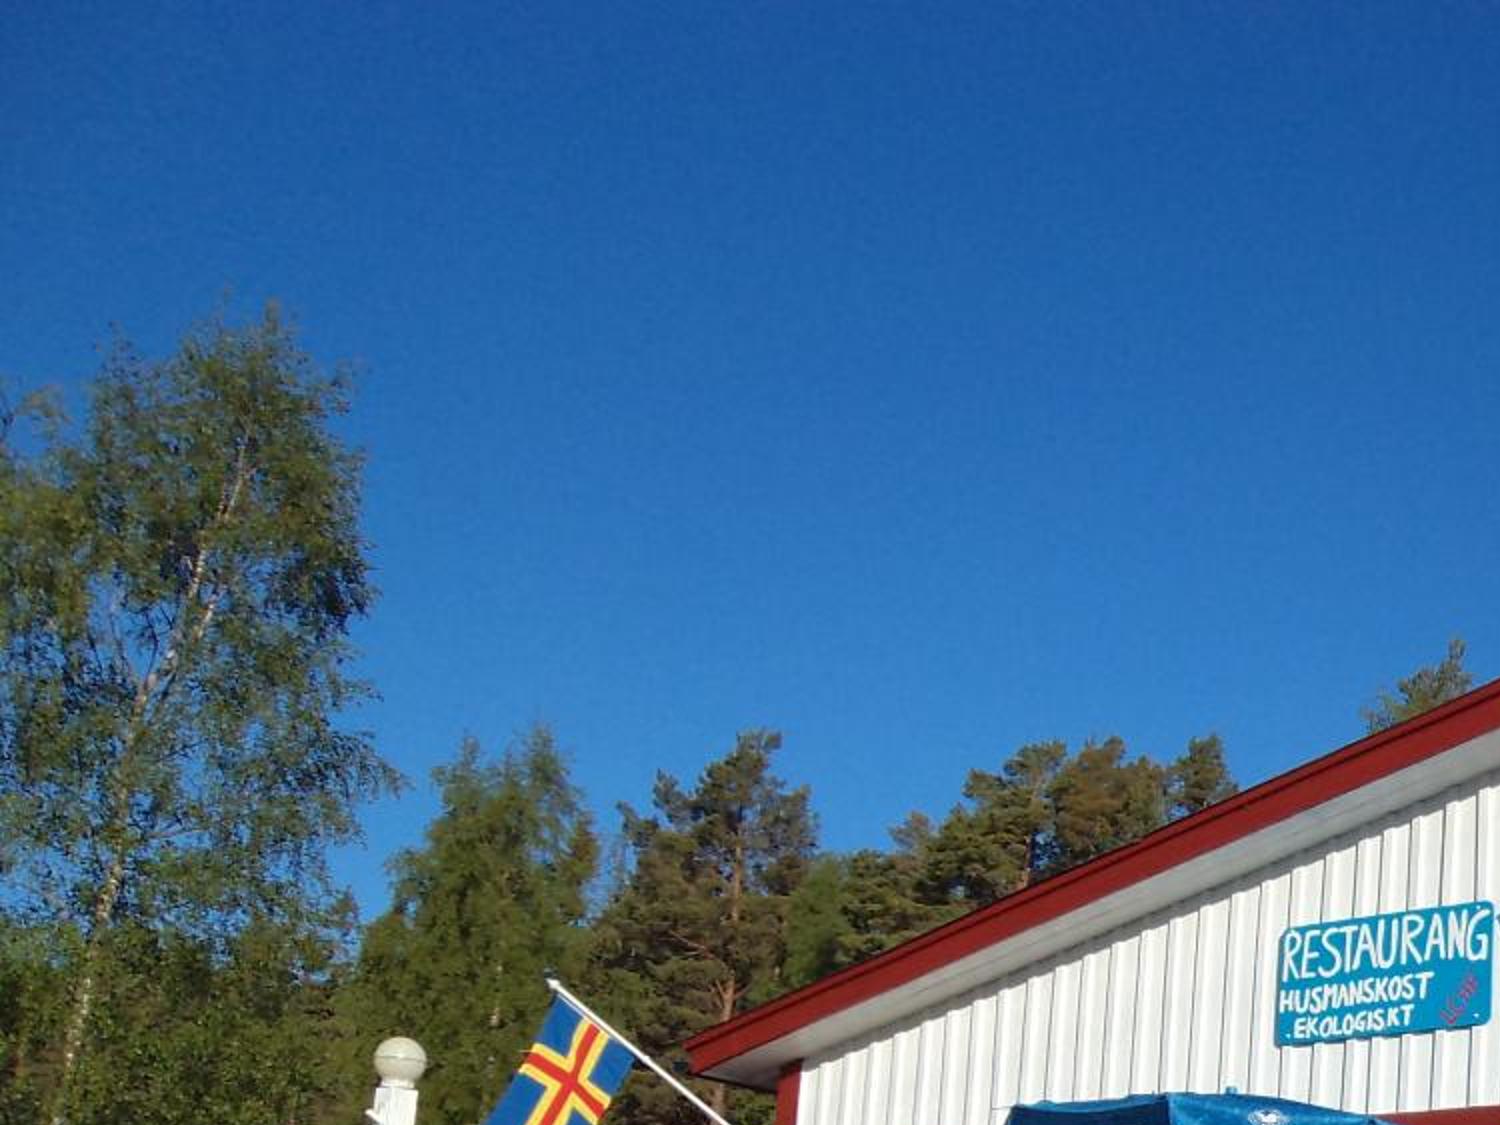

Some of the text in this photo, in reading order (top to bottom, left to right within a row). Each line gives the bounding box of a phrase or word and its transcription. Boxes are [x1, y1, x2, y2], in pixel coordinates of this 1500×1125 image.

[1282, 905, 1489, 982] RESTAURANG
[1280, 972, 1434, 1016] HUSMANSKOST
[1292, 1004, 1414, 1040] EKOLOGISKT
